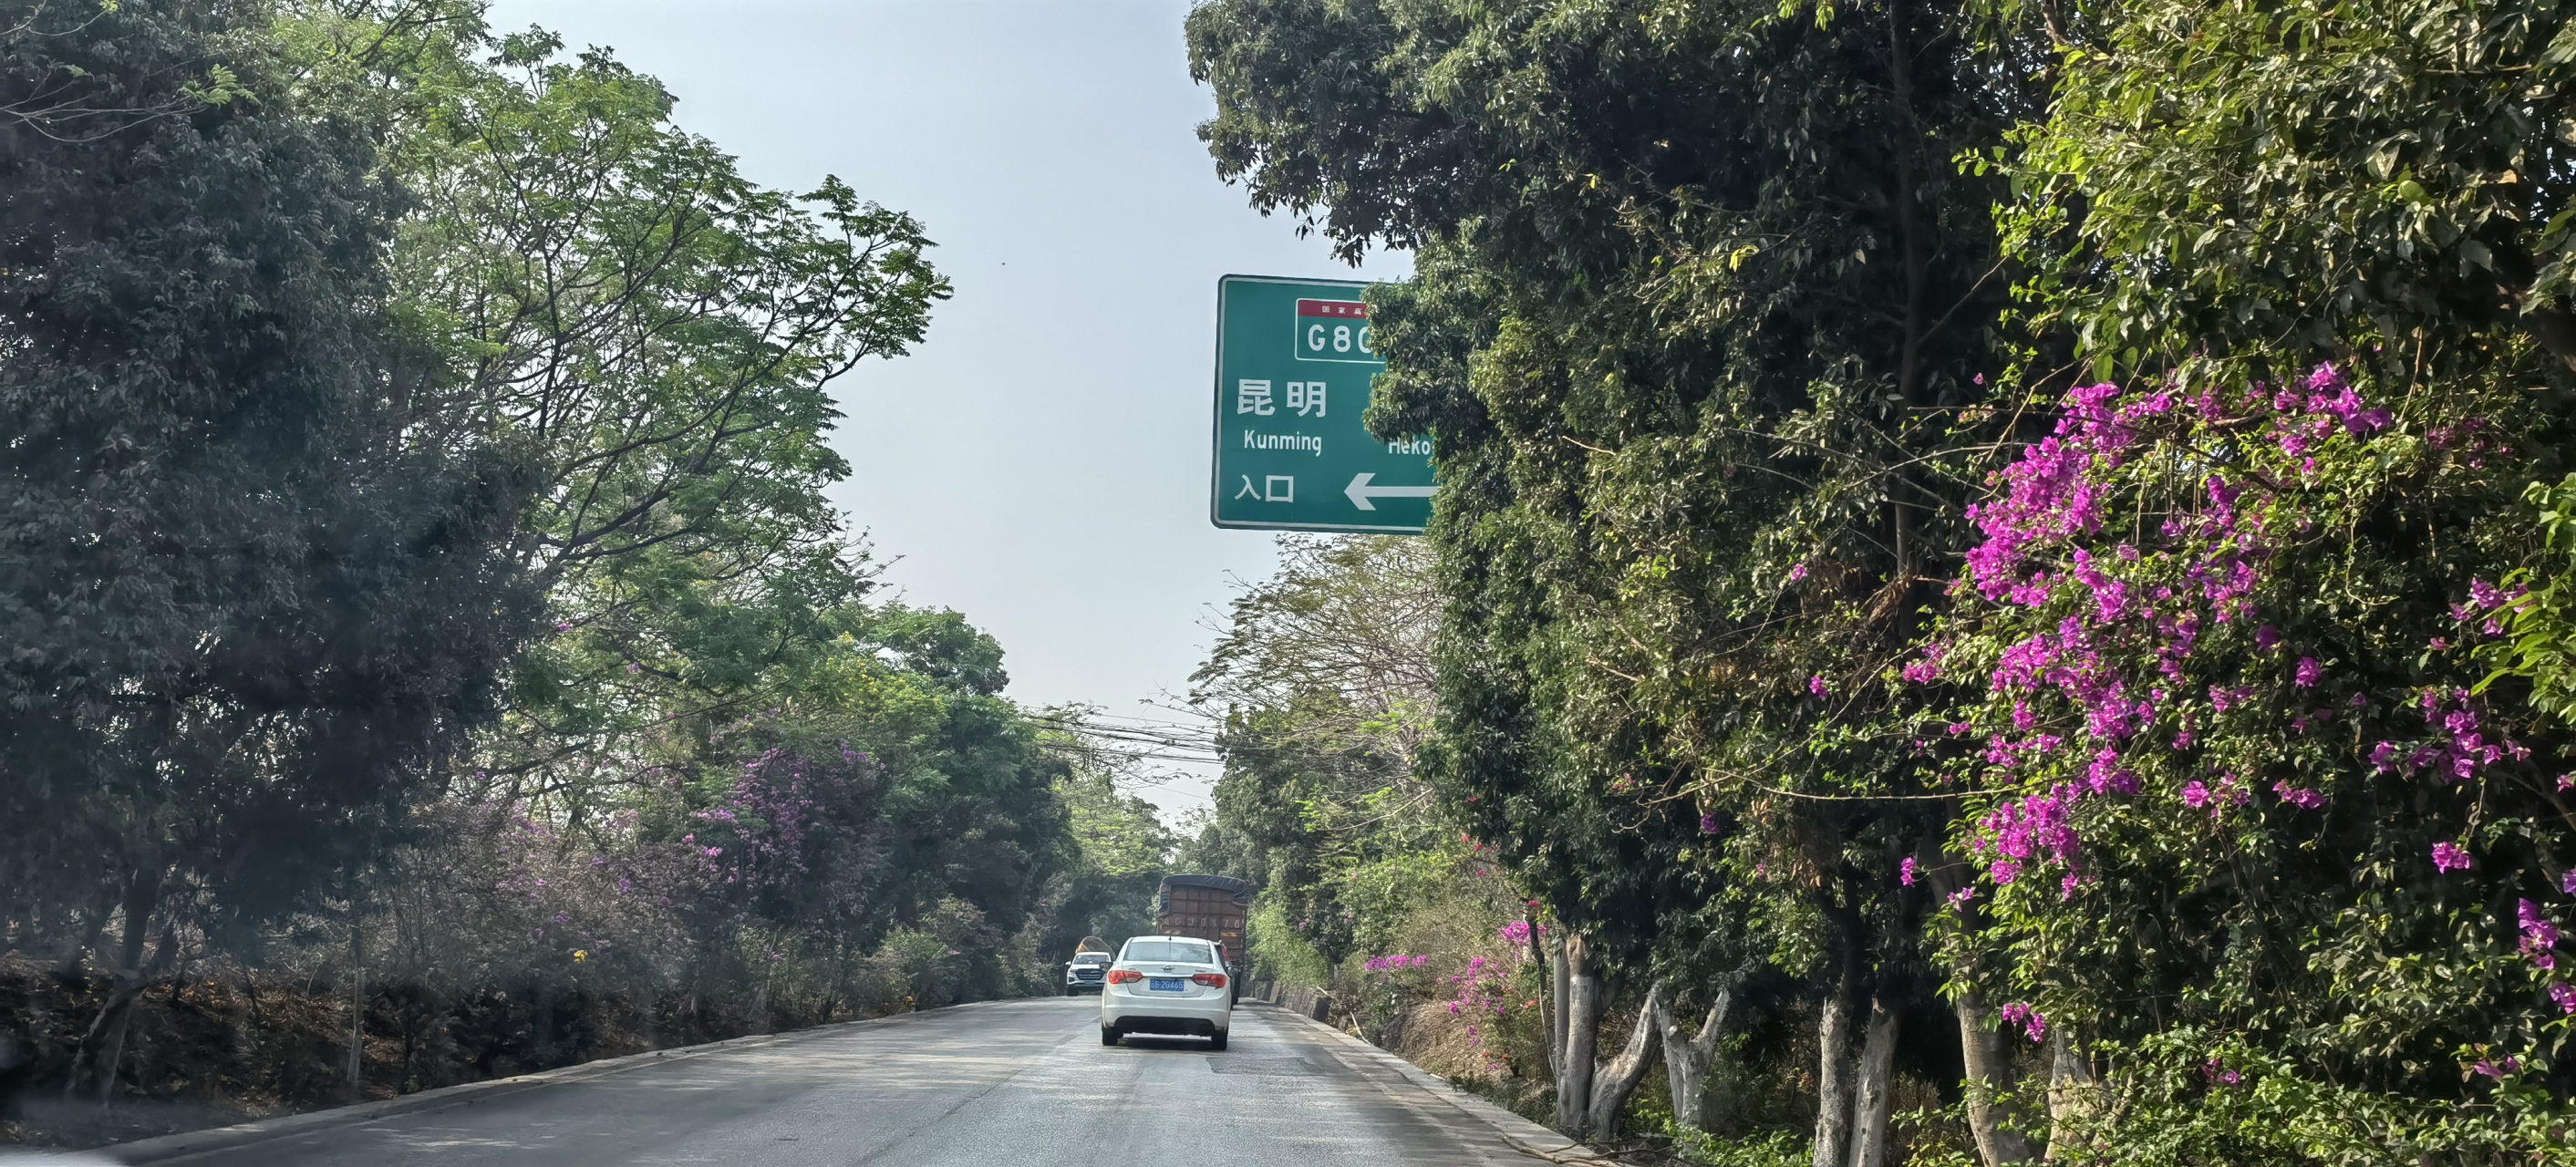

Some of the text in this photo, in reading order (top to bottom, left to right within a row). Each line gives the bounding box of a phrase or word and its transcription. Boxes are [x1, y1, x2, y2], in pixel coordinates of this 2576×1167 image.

[1236, 378, 1327, 418] 昆明
[1244, 429, 1322, 457] Kunming
[1388, 436, 1435, 455] Heko
[1234, 474, 1294, 503] 入口
